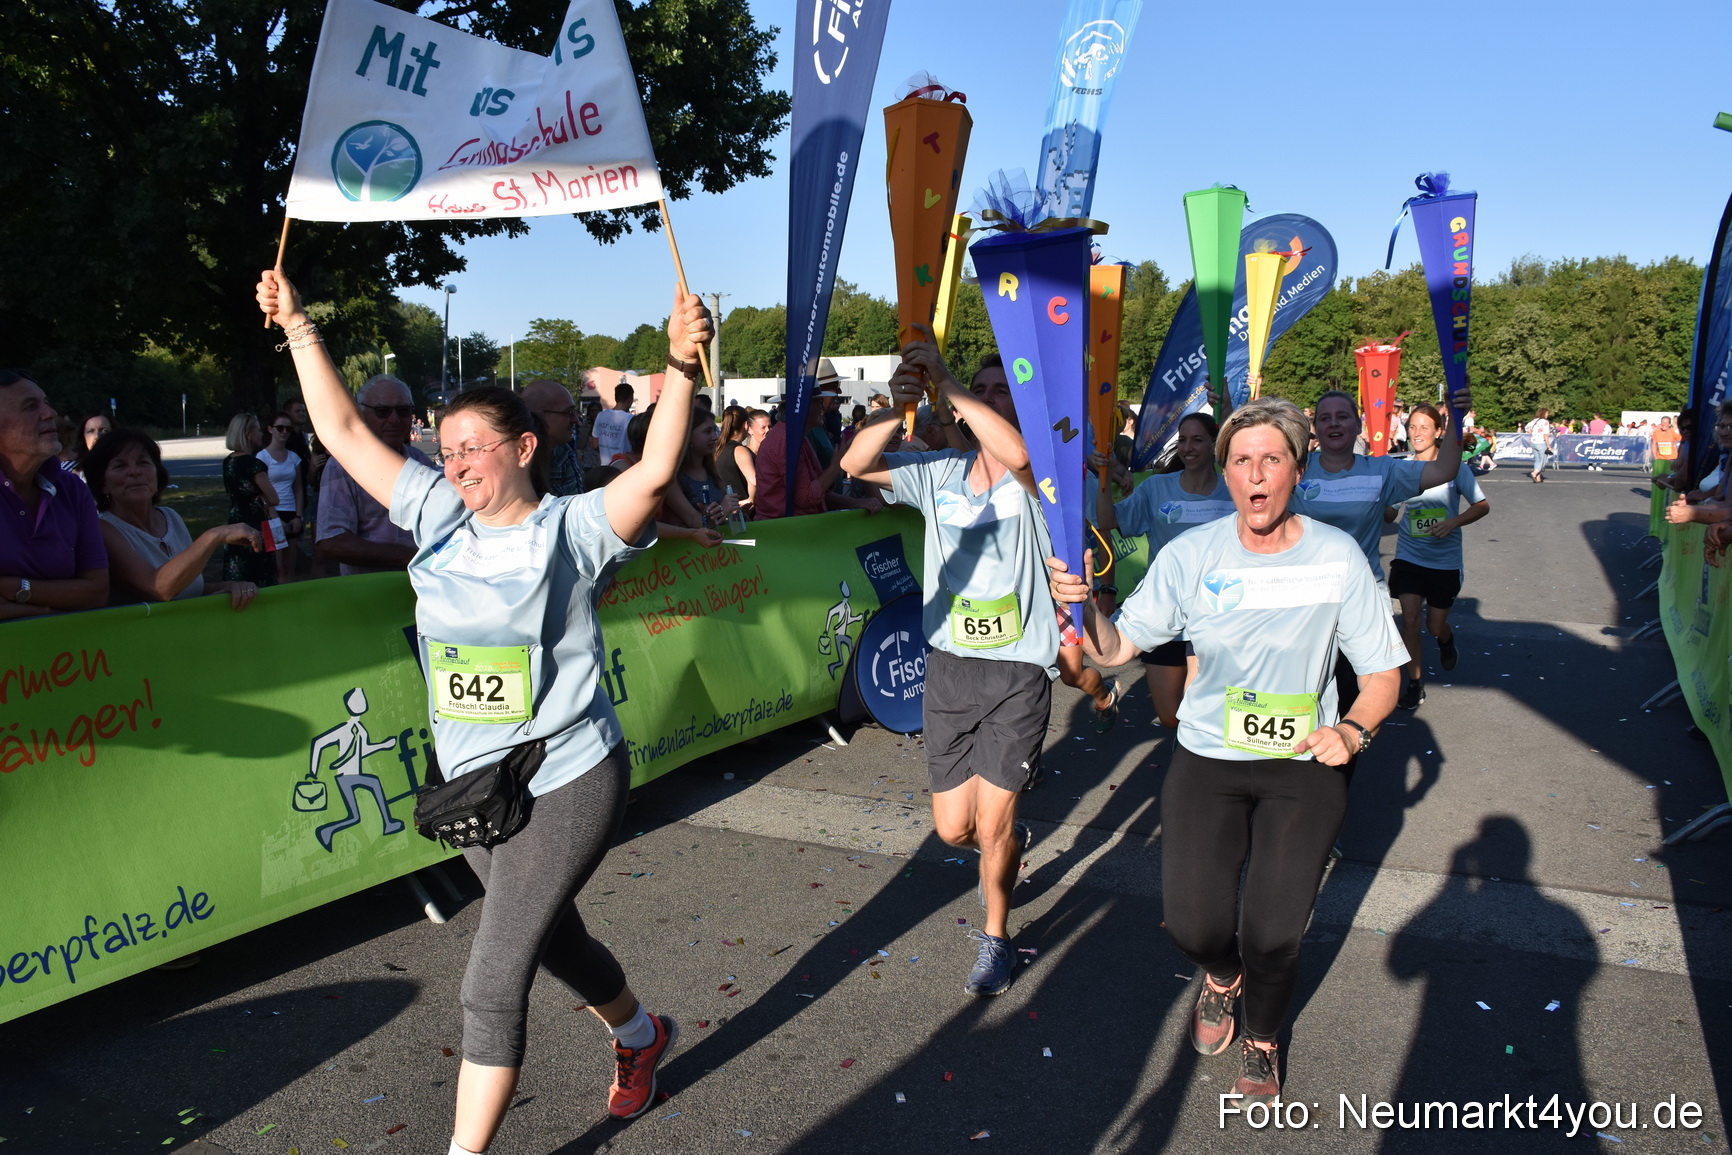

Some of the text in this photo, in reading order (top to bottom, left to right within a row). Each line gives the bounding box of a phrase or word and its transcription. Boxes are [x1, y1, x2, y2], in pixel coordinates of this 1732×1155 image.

[355, 24, 441, 97] Mit
[532, 164, 640, 203] Marien
[794, 150, 849, 414] www.fischer-automobile.de
[914, 264, 933, 287] K
[998, 271, 1019, 302] R
[1287, 263, 1326, 299] Medien
[1450, 216, 1469, 365] GRUNDSCHULE
[1047, 295, 1070, 326] C
[1584, 445, 1628, 456] Fischer
[676, 546, 743, 581] Firmen
[871, 557, 900, 576] Fischer
[639, 564, 769, 637] laufen länger!
[964, 616, 1003, 636] 651
[980, 633, 1007, 642] Christian
[449, 673, 505, 702] 642
[903, 681, 926, 701] AUTO
[448, 700, 510, 711] Frötschl Claudia
[1243, 713, 1296, 741] 645
[1246, 736, 1292, 748] Süllner Petra
